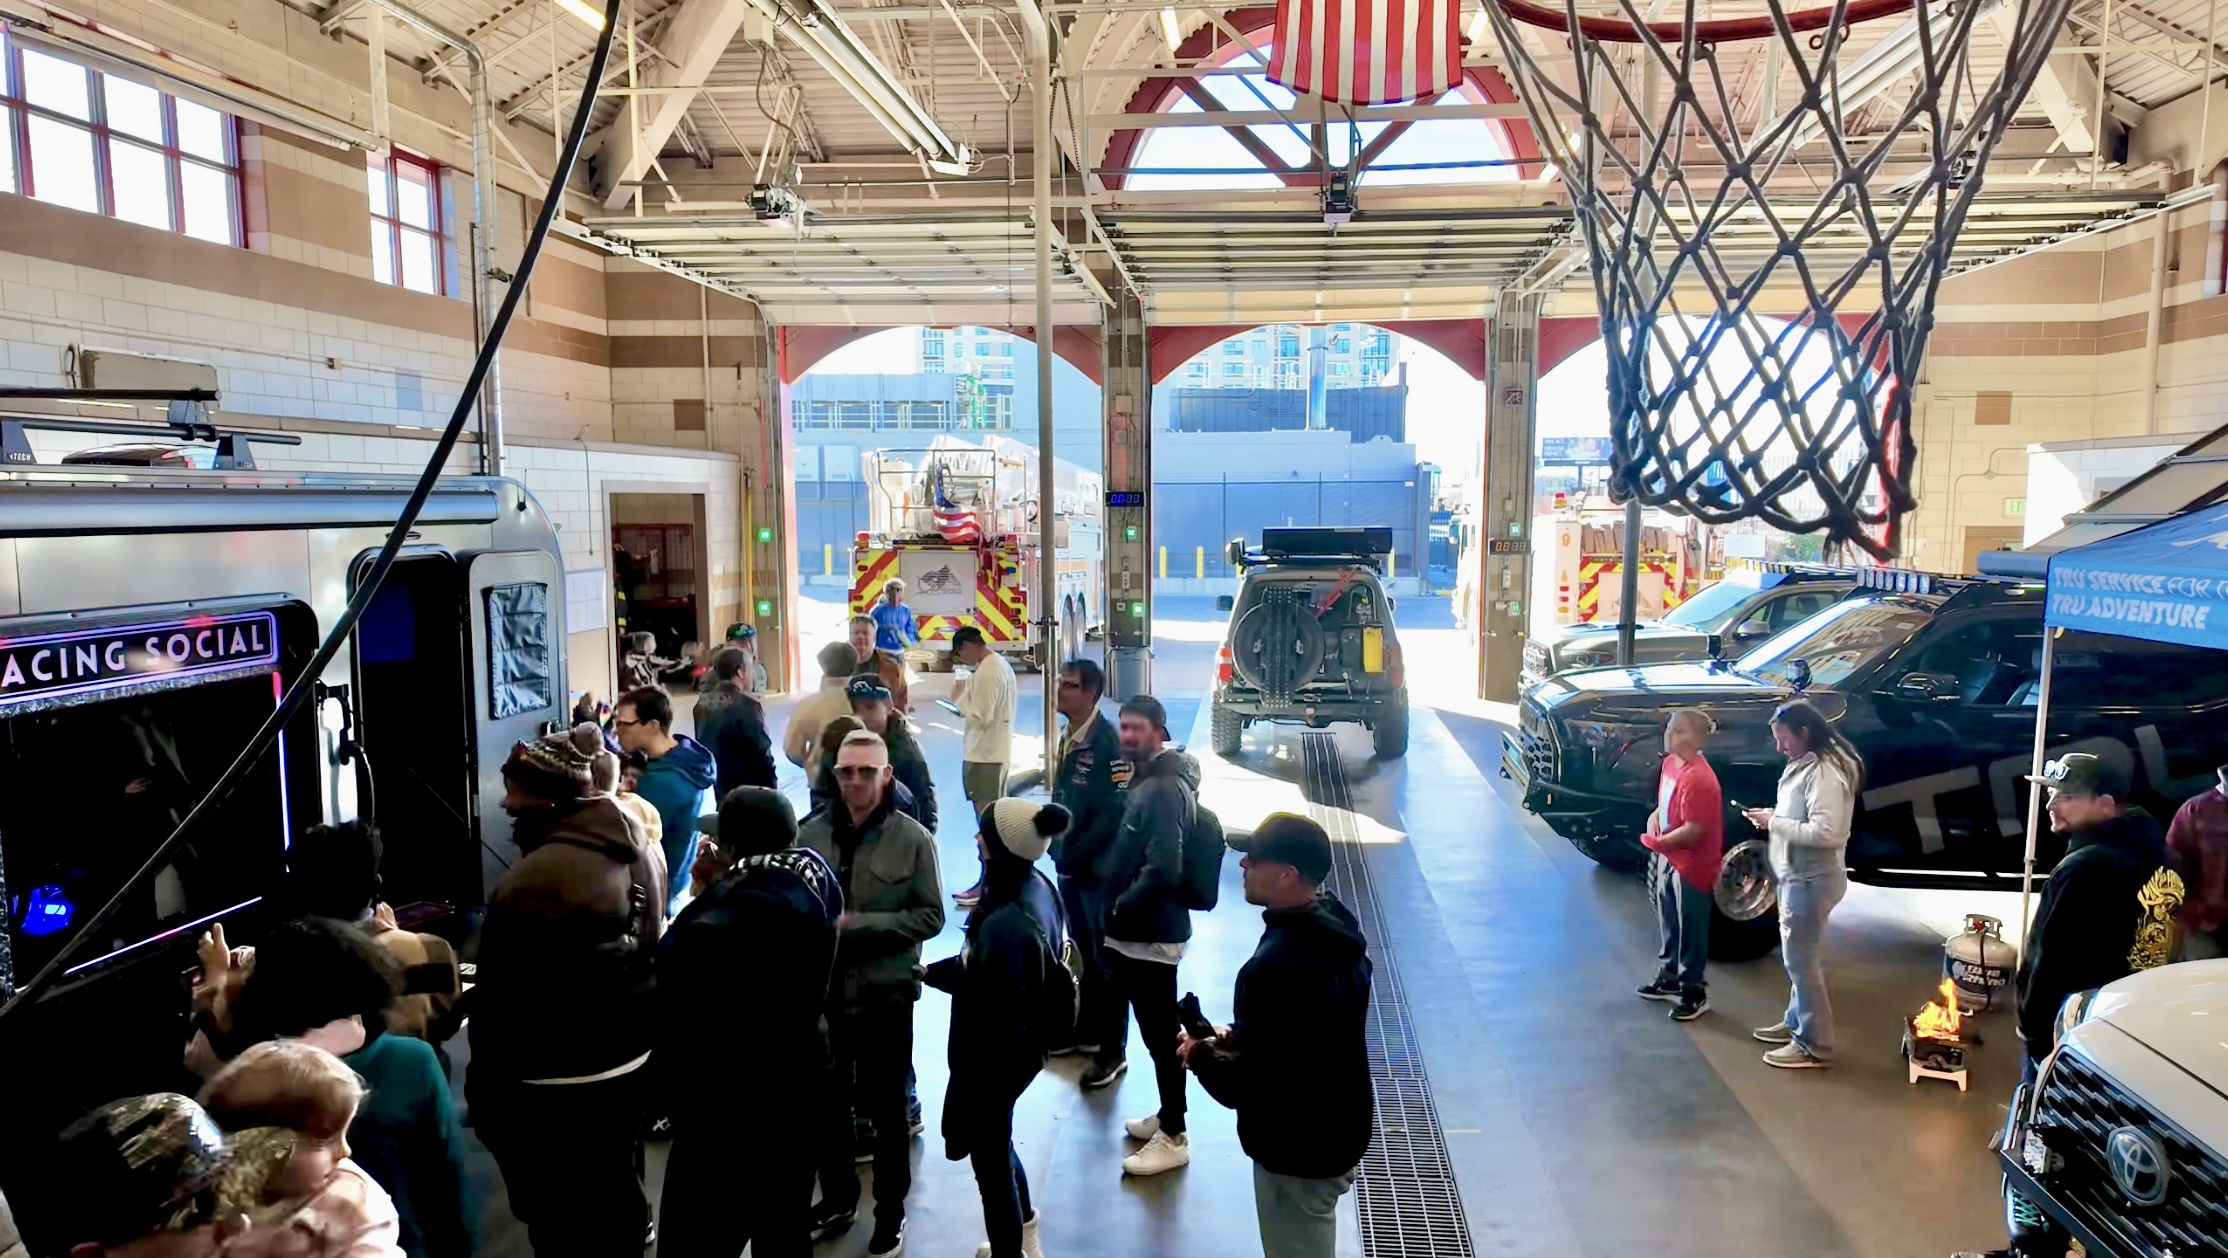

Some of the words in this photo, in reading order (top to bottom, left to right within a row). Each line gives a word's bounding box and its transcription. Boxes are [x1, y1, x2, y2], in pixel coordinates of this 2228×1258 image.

[2054, 567, 2087, 589] TRU
[2087, 570, 2168, 595] SERVICE
[2167, 577, 2212, 599] FOR
[2052, 593, 2087, 616] TRU
[2084, 596, 2211, 630] ADVENTURE
[1, 641, 127, 688] ACING
[145, 625, 265, 666] SOCIAL
